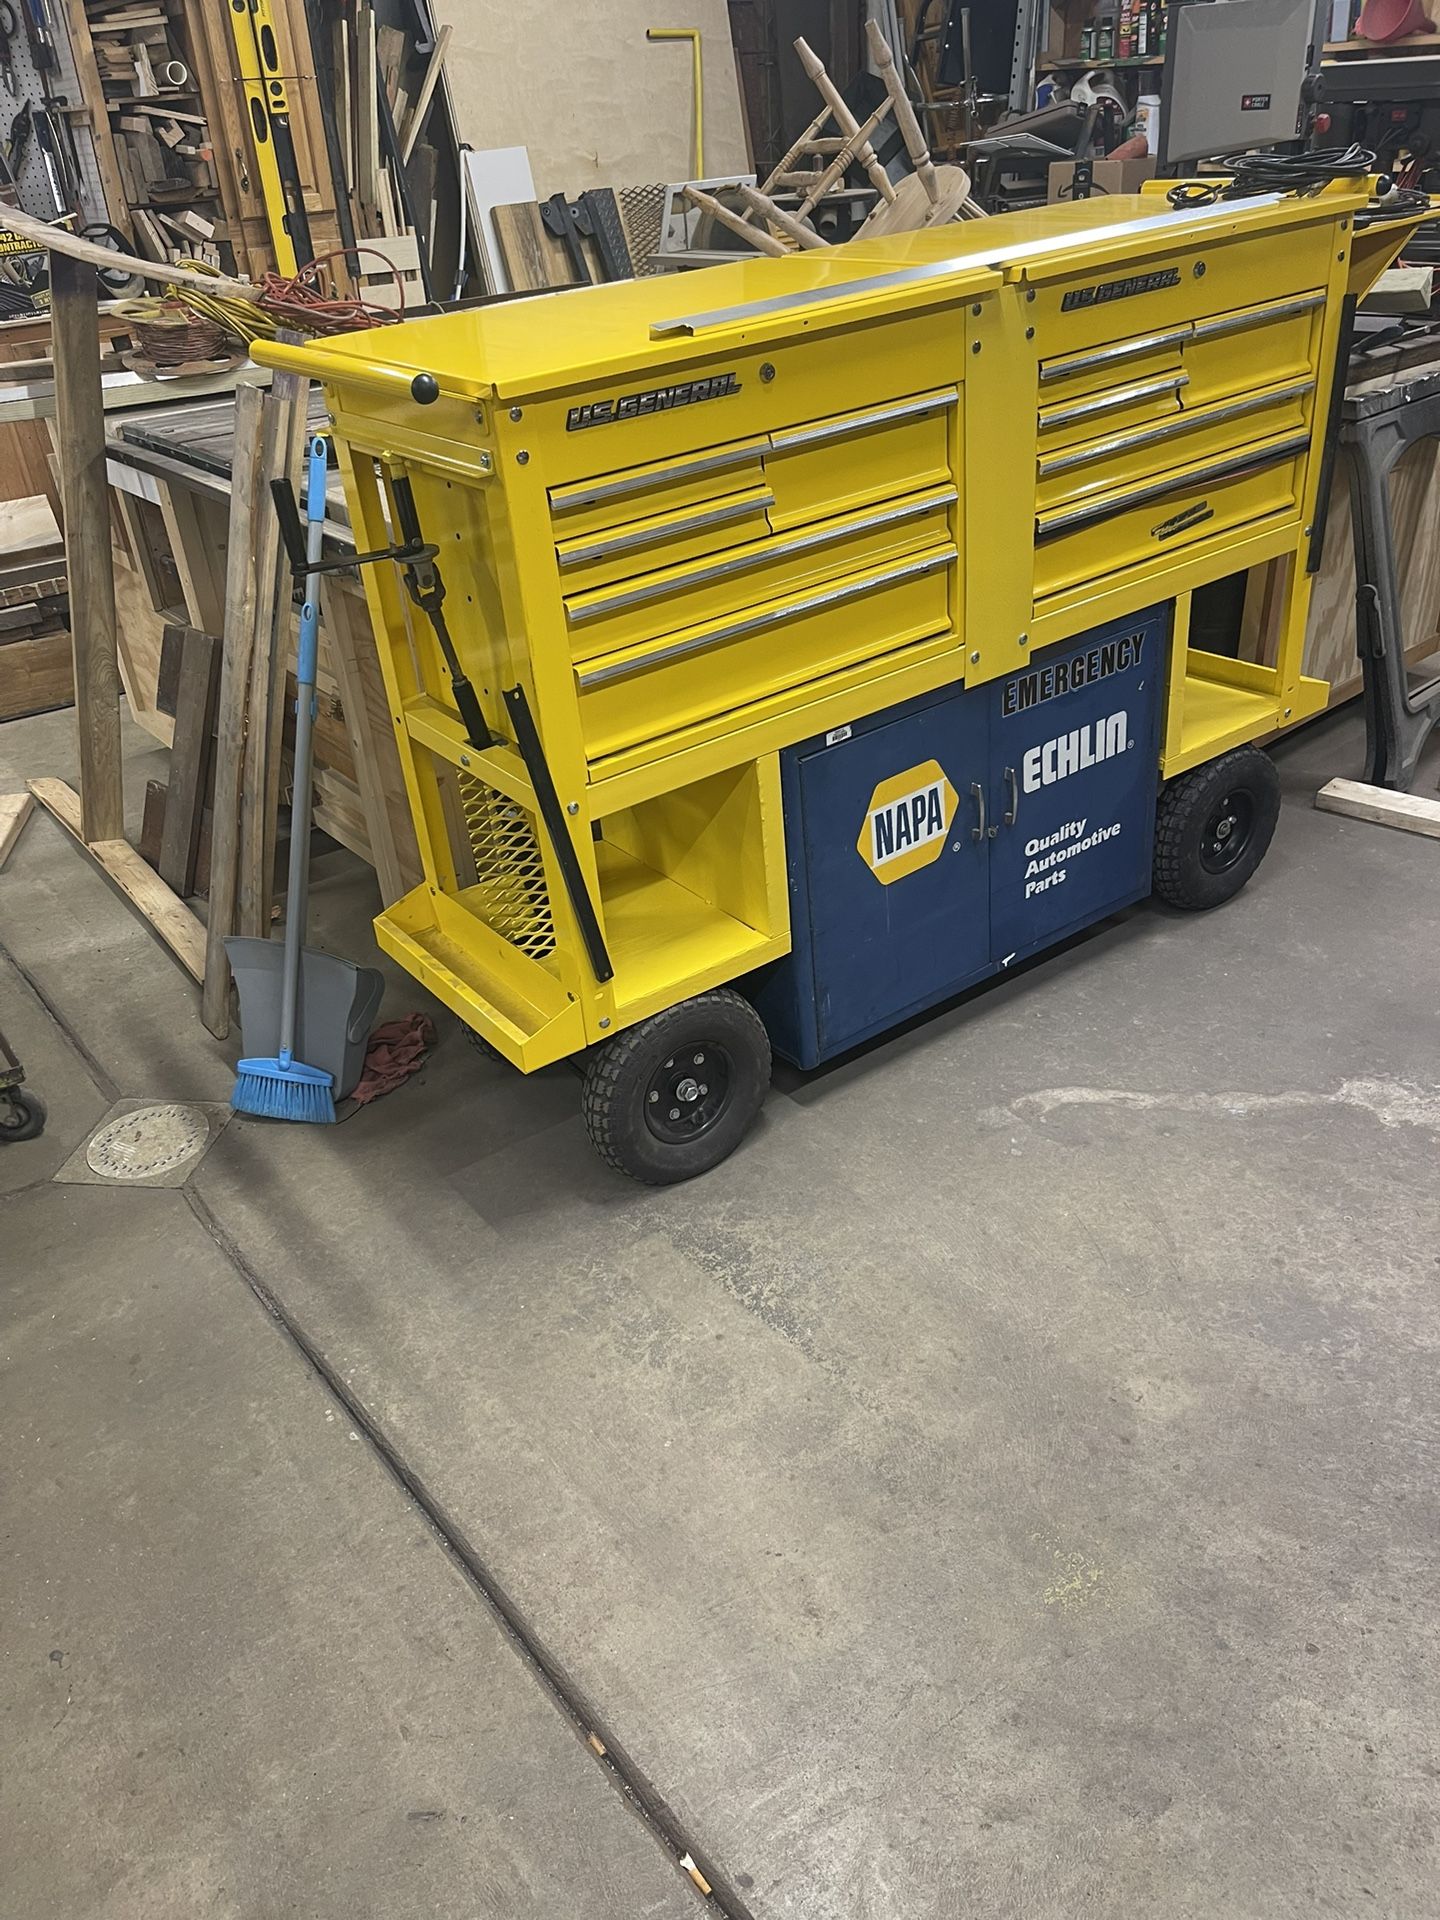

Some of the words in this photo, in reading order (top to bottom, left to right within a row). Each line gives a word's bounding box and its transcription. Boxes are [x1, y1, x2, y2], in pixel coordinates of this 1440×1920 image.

[616, 372, 743, 420] GENERAL
[1002, 631, 1147, 718] EMERGENCY
[1023, 710, 1128, 794] ECHLIN
[874, 787, 943, 860] NAPA
[1024, 818, 1087, 857] Quality
[1024, 823, 1121, 879] Automotive
[1025, 869, 1067, 899] Parts
